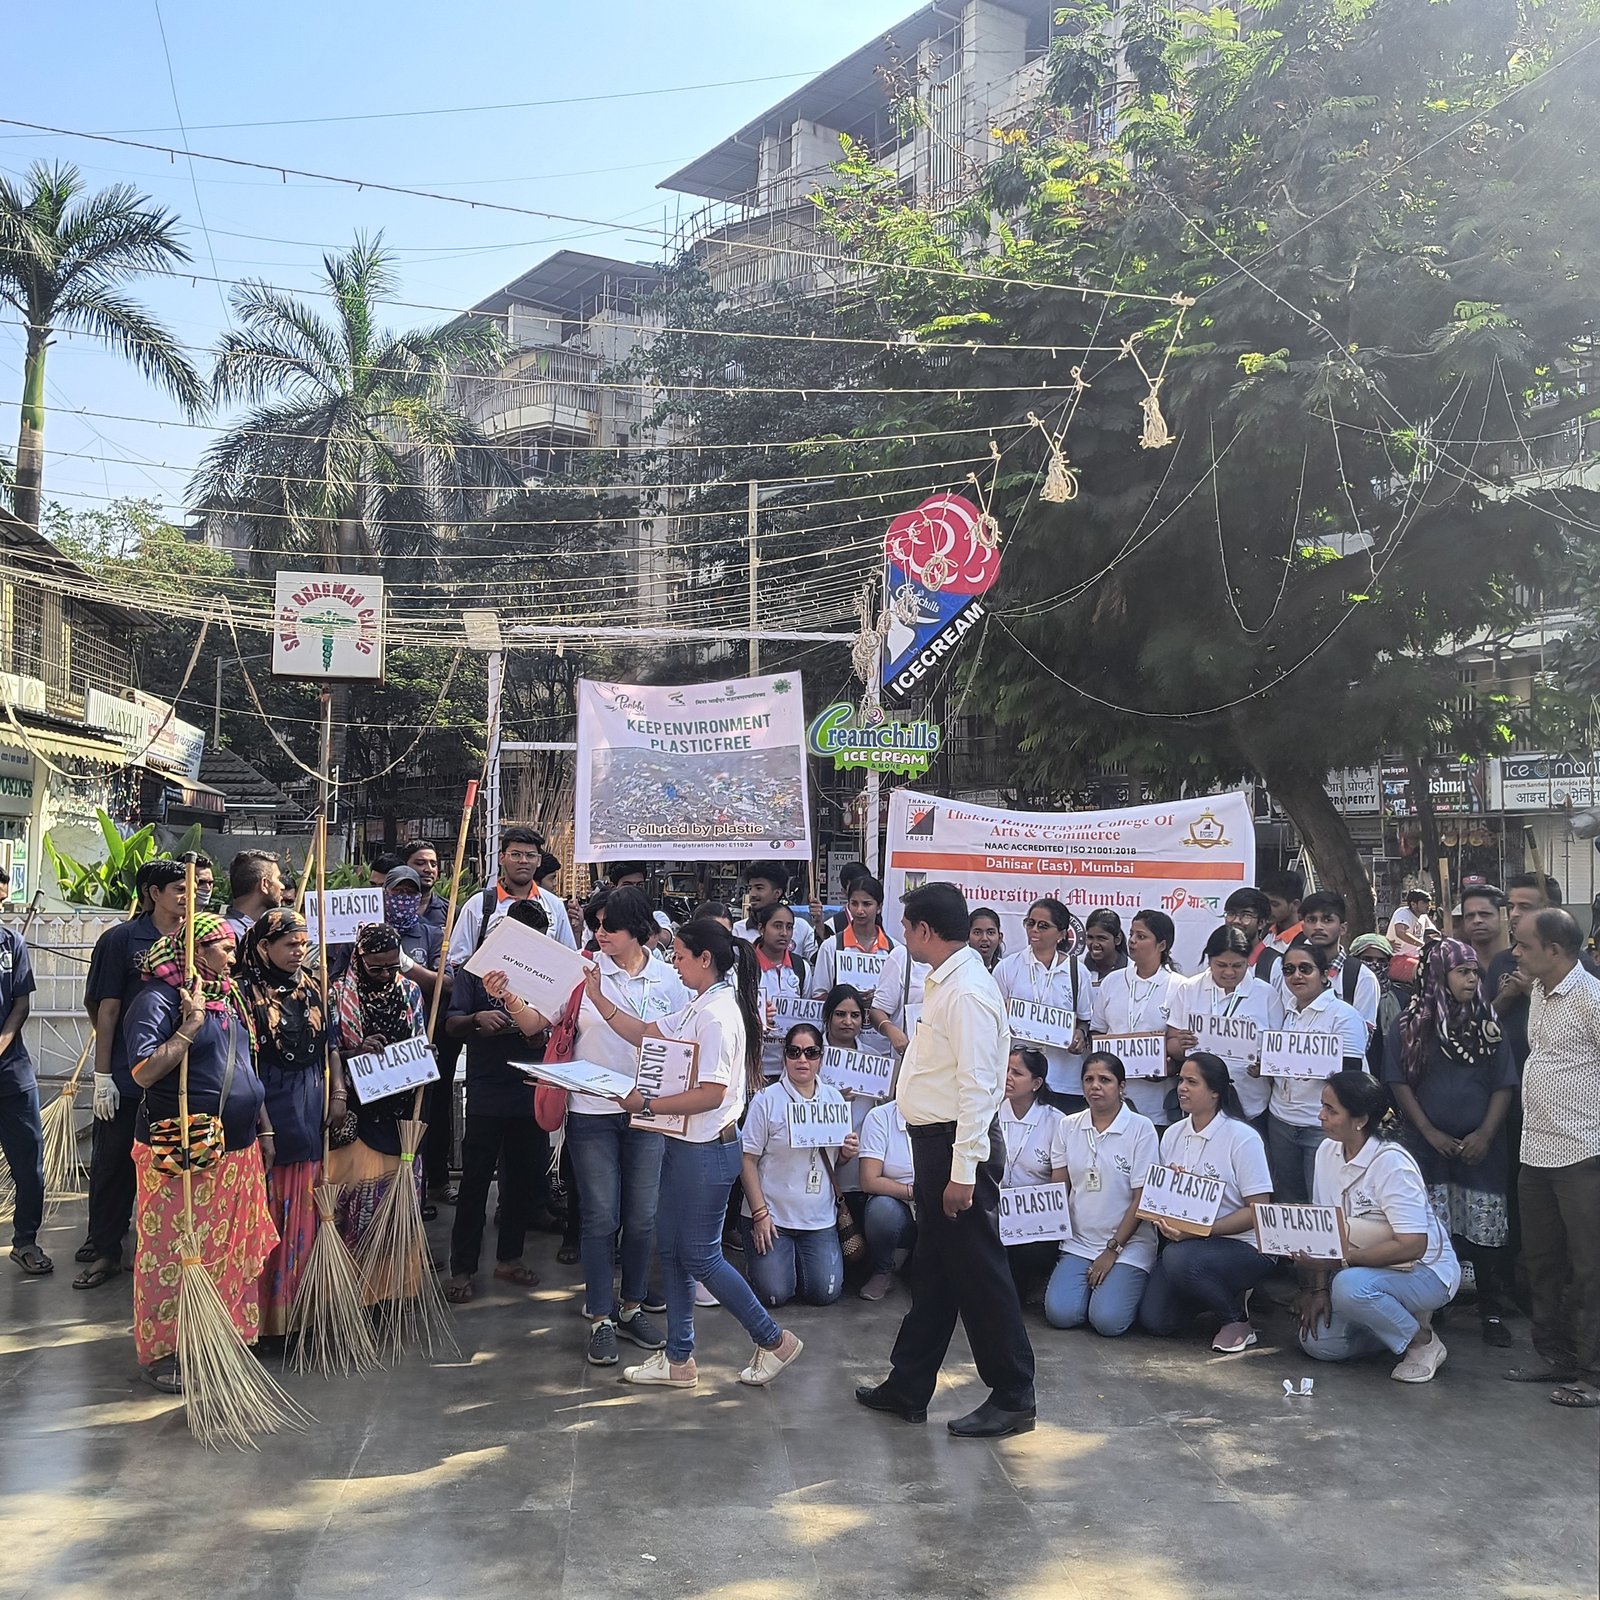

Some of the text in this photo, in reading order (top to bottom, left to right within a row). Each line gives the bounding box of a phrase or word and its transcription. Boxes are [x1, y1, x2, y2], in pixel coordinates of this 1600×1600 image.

[891, 602, 985, 696] ICECREAM
[627, 714, 770, 735] KEEP ENVIRONMENT
[810, 704, 938, 754] Creamchills
[651, 735, 751, 753] PLASTIC FREE
[843, 751, 924, 765] ICE CREAM
[1429, 777, 1466, 794] ishna
[628, 823, 763, 836] Polluted by plastic
[946, 809, 1174, 832] Thakur Ramnarayan College Of
[990, 825, 1120, 841] Arts & Commerce
[984, 843, 1009, 851] NAAC
[1011, 844, 1064, 853] ACCREDITED
[1071, 845, 1085, 854] ISO
[1087, 846, 1137, 855] 21001:2018
[986, 857, 1135, 874] Dahisar (East), Mumbai
[310, 894, 379, 917] N PLASTIC
[953, 883, 1141, 907] niversity of Mumbai
[502, 954, 514, 963] SAY
[513, 960, 524, 968] NO
[532, 970, 555, 984] PLASTIC
[840, 955, 886, 974] NO PLAST
[776, 998, 787, 1015] NO
[792, 1000, 823, 1019] PLAST
[1011, 1000, 1072, 1029] NO PLASTIC
[1188, 1013, 1257, 1041] NO PLASTIC
[1116, 1037, 1160, 1057] PLASTIC
[1267, 1032, 1339, 1056] NO PLASTIC
[353, 1038, 427, 1078] NO PLASTIC
[826, 1047, 890, 1077] NO PLASTIC
[637, 1043, 667, 1098] PLASTIC
[792, 1104, 848, 1124] NO PLASTIC
[1147, 1165, 1220, 1202] NO PLASTIC
[1015, 1190, 1064, 1216] PLASTIC
[1260, 1206, 1333, 1232] NO PLASTIC
